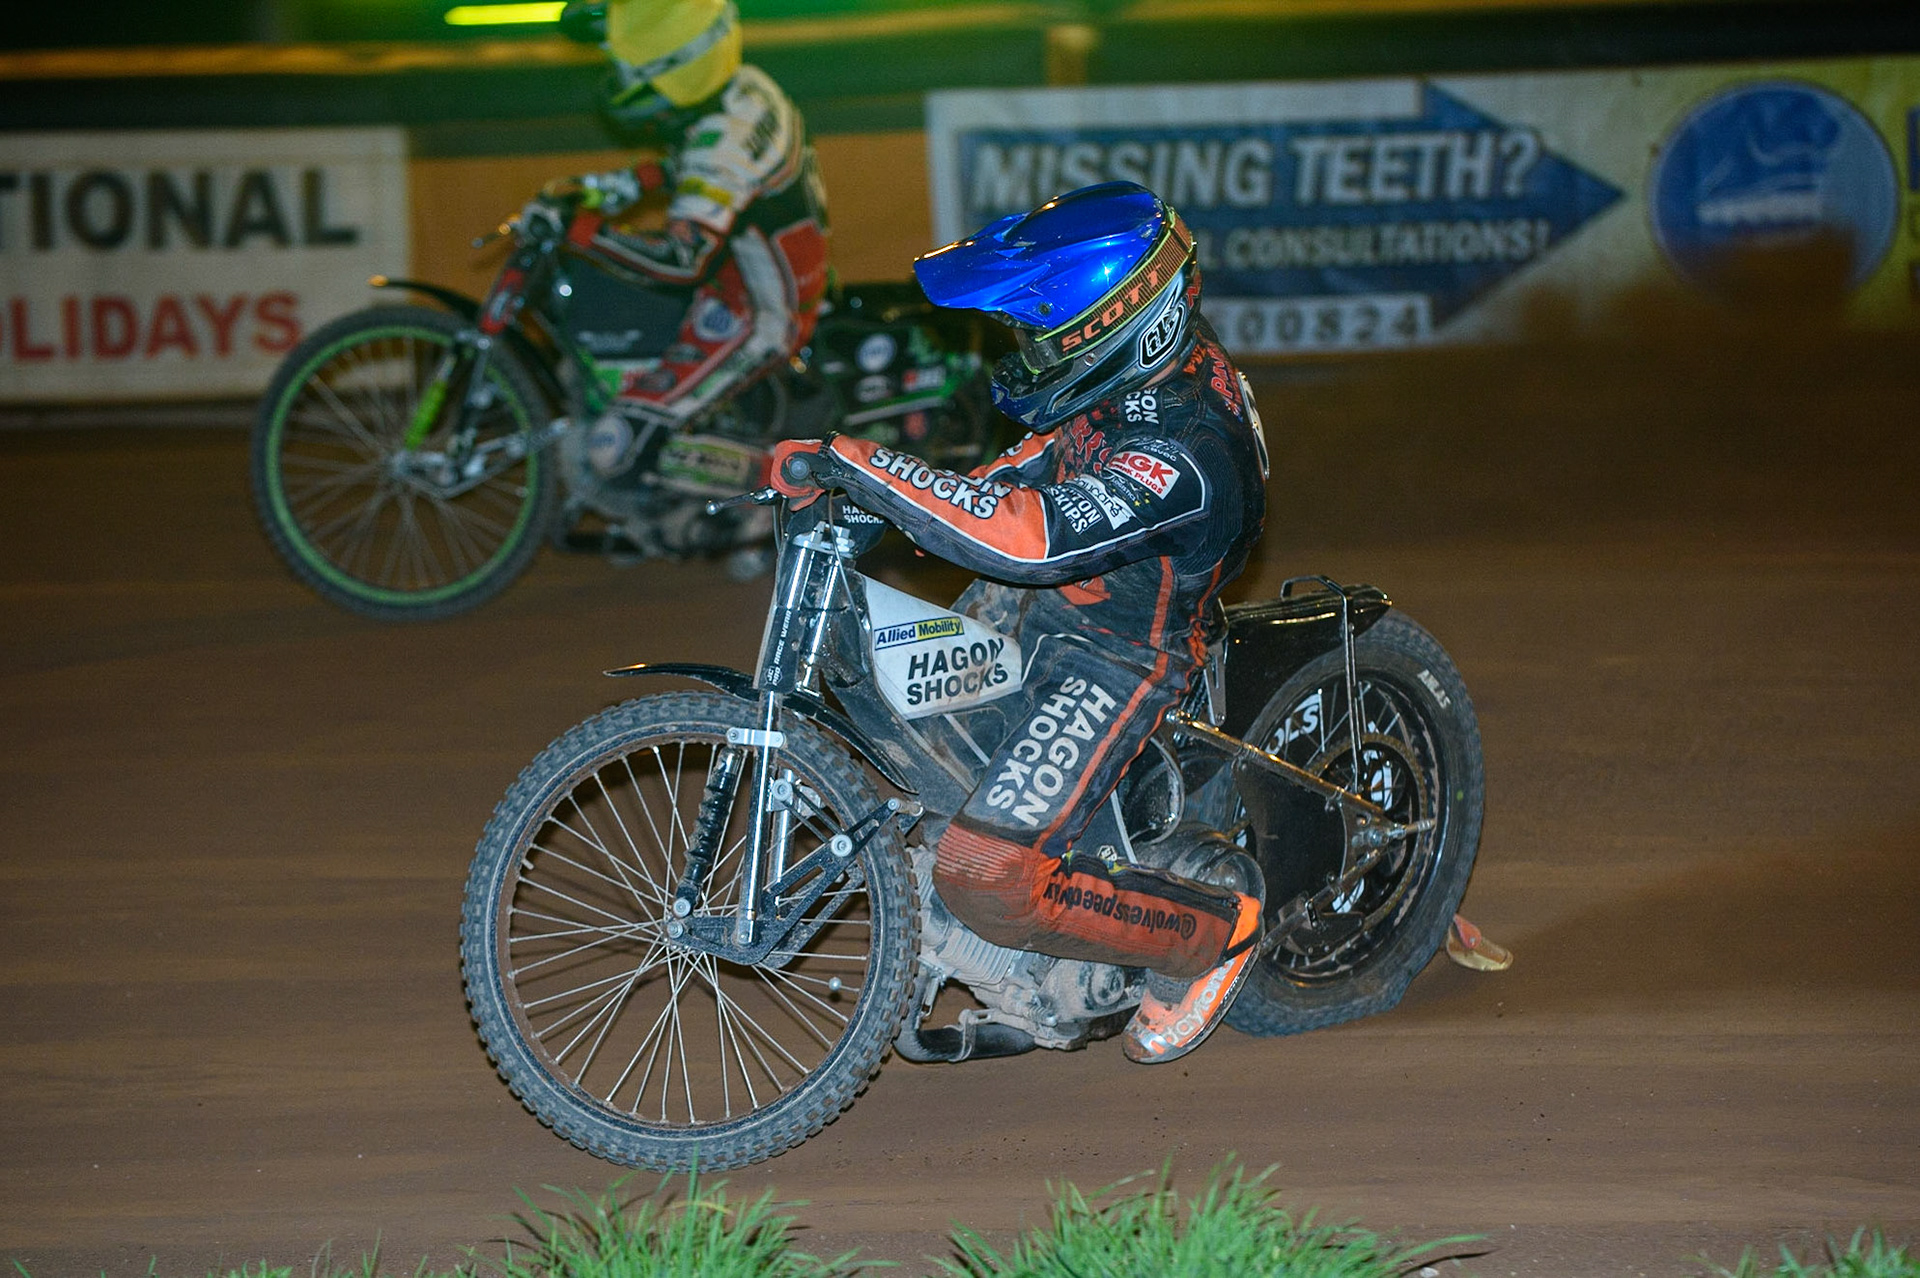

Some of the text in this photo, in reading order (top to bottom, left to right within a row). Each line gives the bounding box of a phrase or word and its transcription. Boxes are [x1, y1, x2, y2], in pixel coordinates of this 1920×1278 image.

[970, 129, 1540, 210] MISSING TEETH?
[1225, 218, 1549, 269] CONSULTATIONS!
[0, 290, 302, 362] LIDAYS
[1062, 264, 1161, 352] SCOTT
[870, 448, 998, 518] SHOCKS
[1134, 473, 1164, 495] PLUGS
[876, 617, 963, 646] Allied Mobility
[907, 637, 1005, 681] HAGON
[907, 663, 1009, 706] SHOCKS
[986, 676, 1087, 809] SHOCKS
[1012, 683, 1117, 828] HAGON
